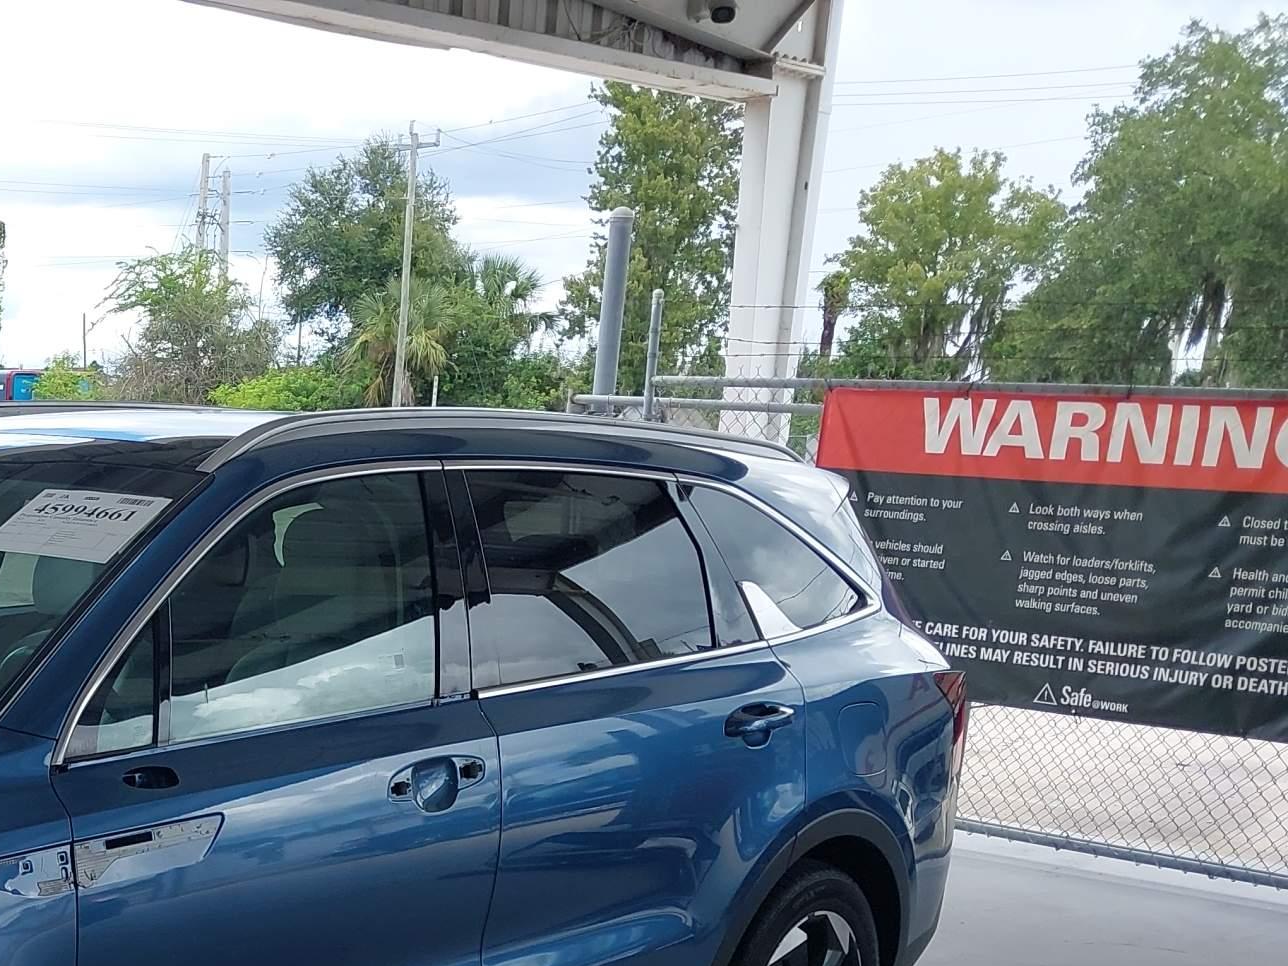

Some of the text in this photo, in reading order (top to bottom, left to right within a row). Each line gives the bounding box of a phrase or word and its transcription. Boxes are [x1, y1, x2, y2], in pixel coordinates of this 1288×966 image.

[867, 492, 963, 510] Pay attention to your
[33, 502, 138, 521] 45994661
[864, 508, 926, 522] surroundings.
[1029, 503, 1143, 521] Look both ways when
[1028, 520, 1106, 535] crossing aisles.
[1242, 516, 1281, 530] Closed
[875, 540, 944, 554] vehicles should
[1239, 535, 1285, 547] must be
[878, 553, 945, 569] iven or started
[1023, 551, 1157, 575] Watch for loaders/forklifts,
[1018, 566, 1149, 590] jagged edges, loose parts,
[1232, 567, 1269, 582] Health
[1017, 582, 1138, 604] sharp points and uneven
[1230, 586, 1265, 598] permit
[1015, 599, 1101, 616] walking surfaces.
[1227, 602, 1253, 614] yard
[1256, 605, 1269, 614] or
[925, 621, 959, 638] CARE
[962, 626, 987, 641] FOR
[991, 628, 1028, 646] YOUR
[1030, 633, 1084, 652] SAFETY.
[1088, 640, 1147, 659] FAILURE
[1150, 646, 1169, 661] TO
[1172, 649, 1233, 669] FOLLOW
[1235, 655, 1288, 675] POSTE
[979, 648, 1011, 663] MAY
[1012, 651, 1065, 669] RESULT
[1067, 657, 1084, 672] IN
[1087, 660, 1151, 680] SERIOUS
[1152, 667, 1208, 686] INJURY
[1211, 674, 1233, 690] OR
[1237, 676, 1288, 696] DEATH
